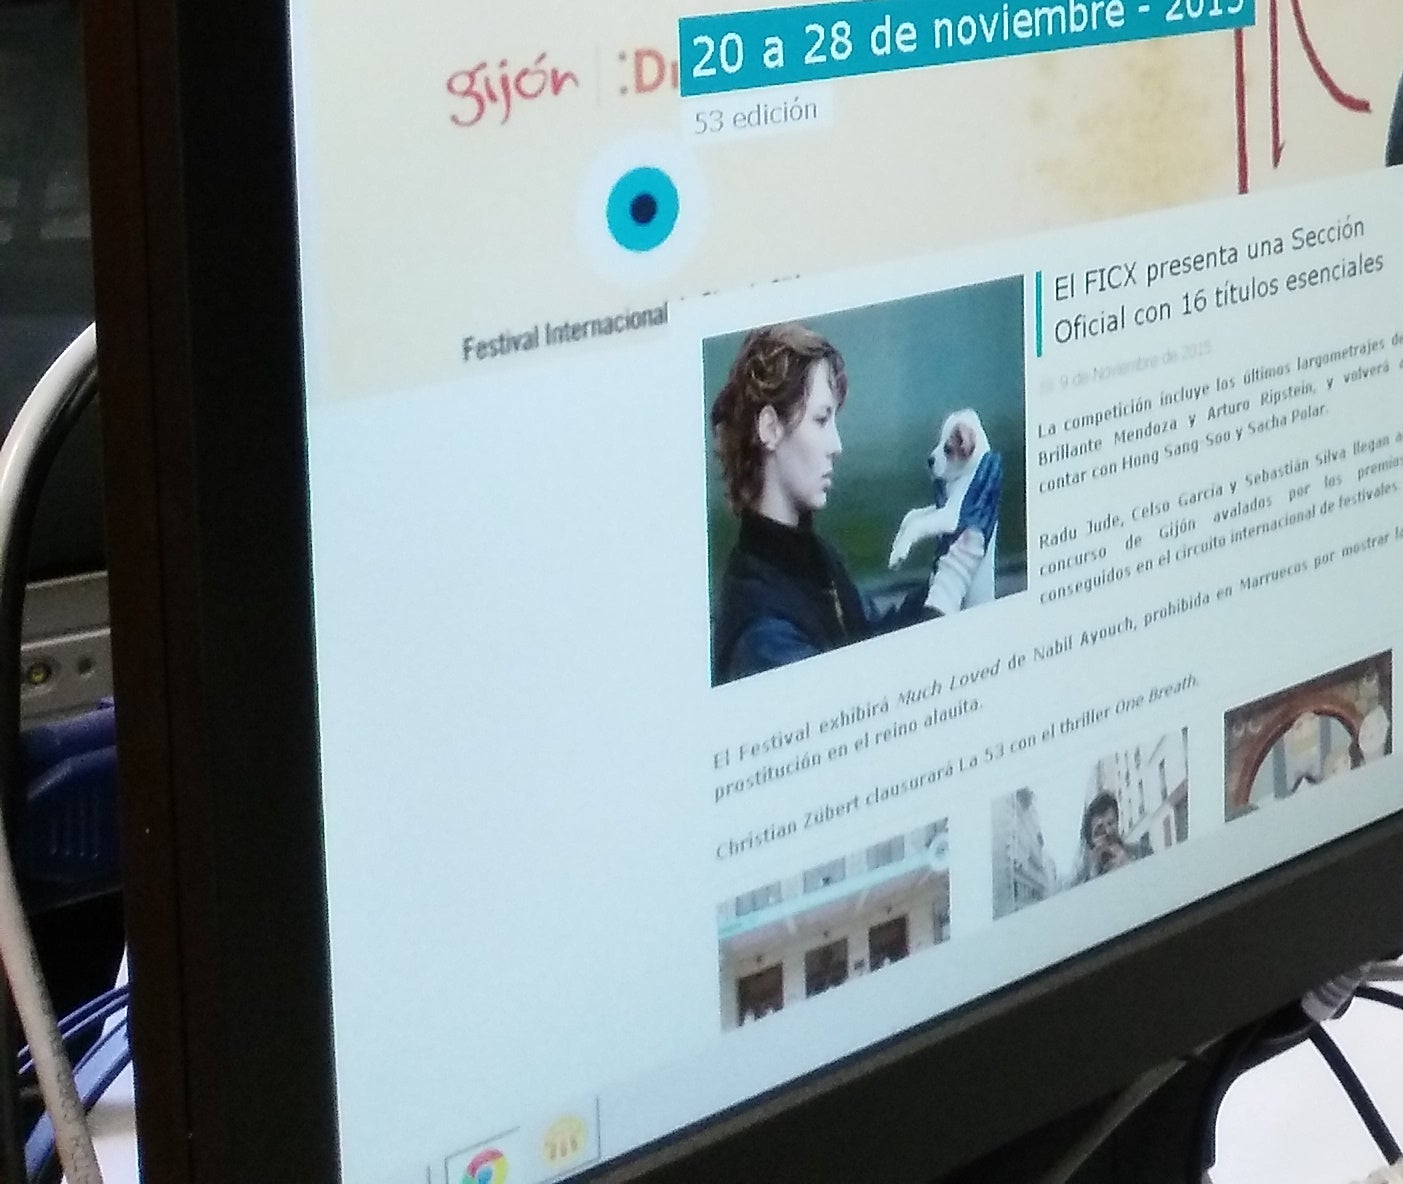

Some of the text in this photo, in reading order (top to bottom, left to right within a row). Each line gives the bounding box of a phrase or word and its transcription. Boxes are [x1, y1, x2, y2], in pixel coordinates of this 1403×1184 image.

[445, 51, 580, 128] gijón
[691, 30, 744, 78] 20
[763, 35, 785, 69] a
[804, 22, 853, 65] 28
[870, 15, 917, 56] de
[693, 95, 818, 136] 53 edición
[1055, 215, 1365, 301] El FICX presenta una Sección
[1055, 252, 1384, 344] Oficial con 16 títulos esenciales
[462, 300, 669, 362] Festival Internacional
[1038, 423, 1056, 438] La
[1064, 397, 1152, 431] competición
[1160, 384, 1209, 406] incluye
[1216, 378, 1235, 392] los
[1243, 363, 1291, 385] últimos
[1297, 338, 1384, 371] largometrajes
[1038, 360, 1389, 466] Brillante Mendoza Arturo Ripstein, volverá
[1039, 469, 1087, 494] contar
[1092, 462, 1117, 479] con
[1122, 450, 1159, 470] Hong
[1165, 438, 1199, 458] Sang
[1206, 429, 1231, 448] Soo
[1248, 414, 1287, 435] Sacha
[1040, 527, 1077, 549] Radu
[1087, 514, 1124, 534] Jude,
[1132, 502, 1170, 521] Celso
[1178, 483, 1223, 507] García
[1245, 460, 1309, 487] Sebastián
[1315, 448, 1346, 465] Silva
[1353, 435, 1389, 456] llegan
[1040, 547, 1107, 577] concurso
[1125, 534, 1142, 550] de
[1160, 518, 1196, 539] Gijón
[1213, 496, 1272, 523] avalados
[1289, 484, 1310, 502] por
[1324, 474, 1342, 489] los
[1040, 566, 1131, 605] conseguidos
[1137, 559, 1153, 574] en
[1159, 549, 1171, 567] el
[1175, 535, 1226, 561] circuito
[1231, 504, 1316, 544] internacional
[1320, 501, 1335, 516] de
[713, 749, 730, 770] El
[738, 722, 810, 762] Festival
[819, 697, 889, 735] exhibirá
[898, 679, 942, 706] Much
[949, 658, 1001, 691] Loved
[1008, 653, 1026, 671] de
[1033, 635, 1073, 662] Nabil
[1080, 616, 1138, 646] Ayouch,
[1144, 591, 1210, 628] prohibida
[1216, 586, 1232, 600] en
[1240, 560, 1308, 591] Marruecos
[1314, 551, 1335, 569] por
[1342, 532, 1389, 558] mostrar
[714, 753, 821, 804] prostitución
[828, 743, 848, 761] en
[854, 732, 869, 752] el
[875, 721, 917, 746] reino
[716, 821, 797, 861] Christian
[866, 765, 953, 806] clausurará
[959, 755, 978, 772] La
[984, 743, 1005, 764] 53
[1010, 734, 1036, 754] con
[1042, 723, 1055, 741] el
[1060, 707, 1111, 735] thriller
[1115, 695, 1144, 715] One
